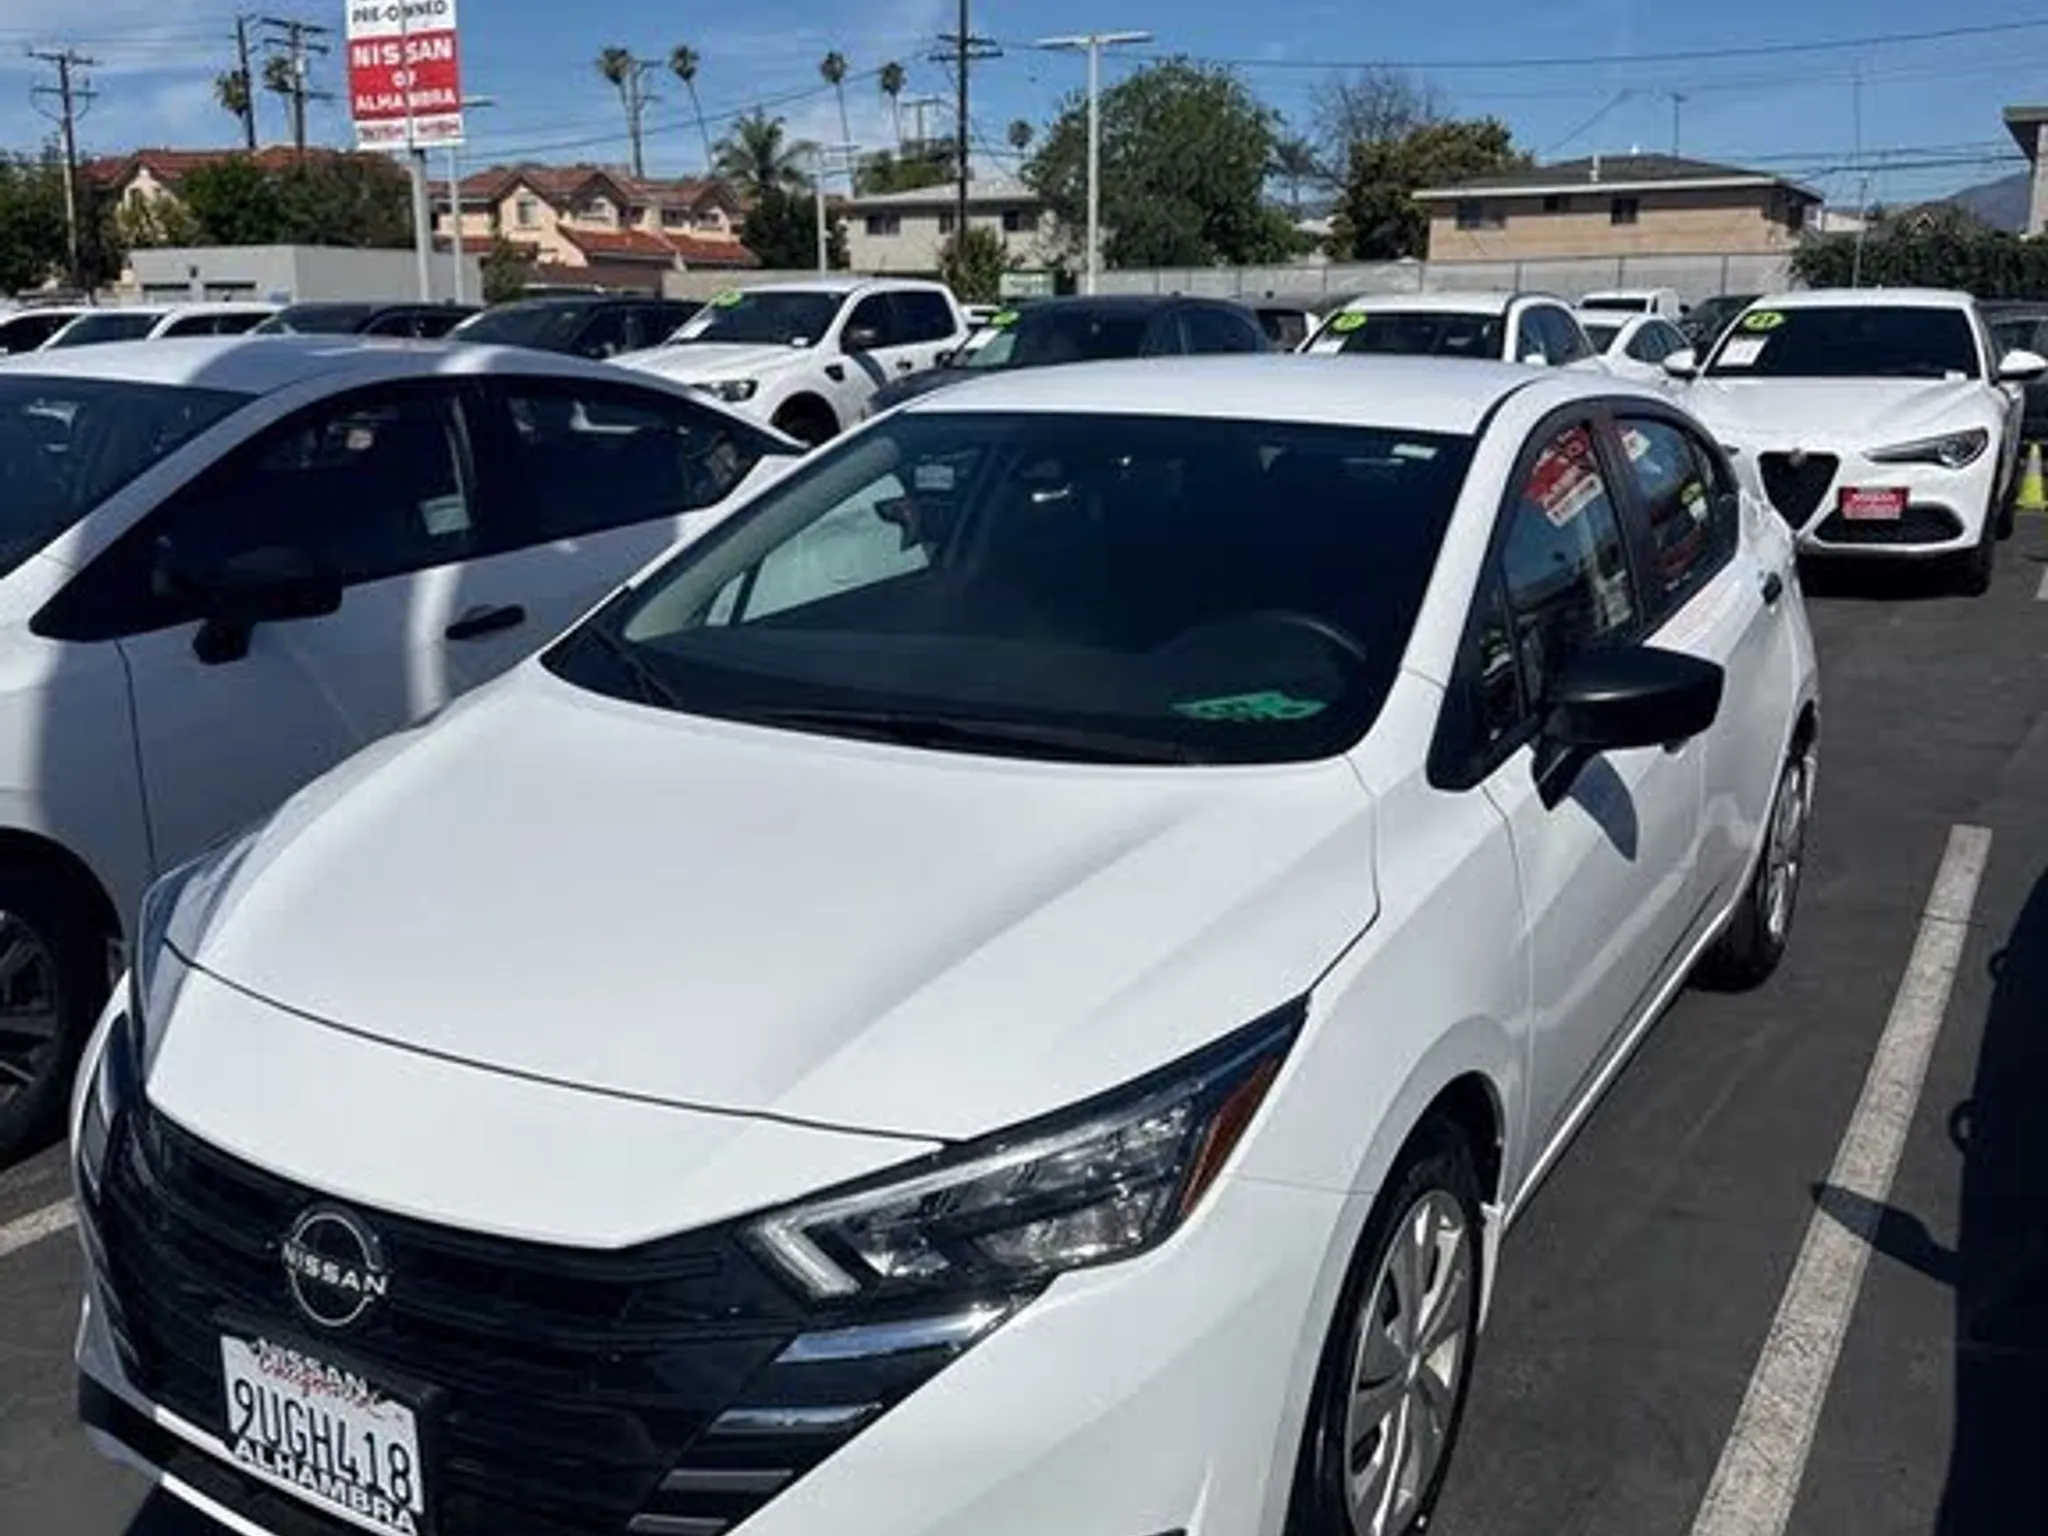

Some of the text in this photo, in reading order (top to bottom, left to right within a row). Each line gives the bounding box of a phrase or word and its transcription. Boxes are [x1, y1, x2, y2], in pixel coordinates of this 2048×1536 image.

[352, 1, 447, 22] PRE-OWNED
[353, 37, 453, 68] NISSAN
[391, 70, 417, 88] OF
[356, 88, 456, 112] ALHAMBRA
[283, 1241, 388, 1296] NISSAN
[234, 1377, 411, 1507] 9UGH418
[234, 1438, 418, 1536] ALHAMBRA
